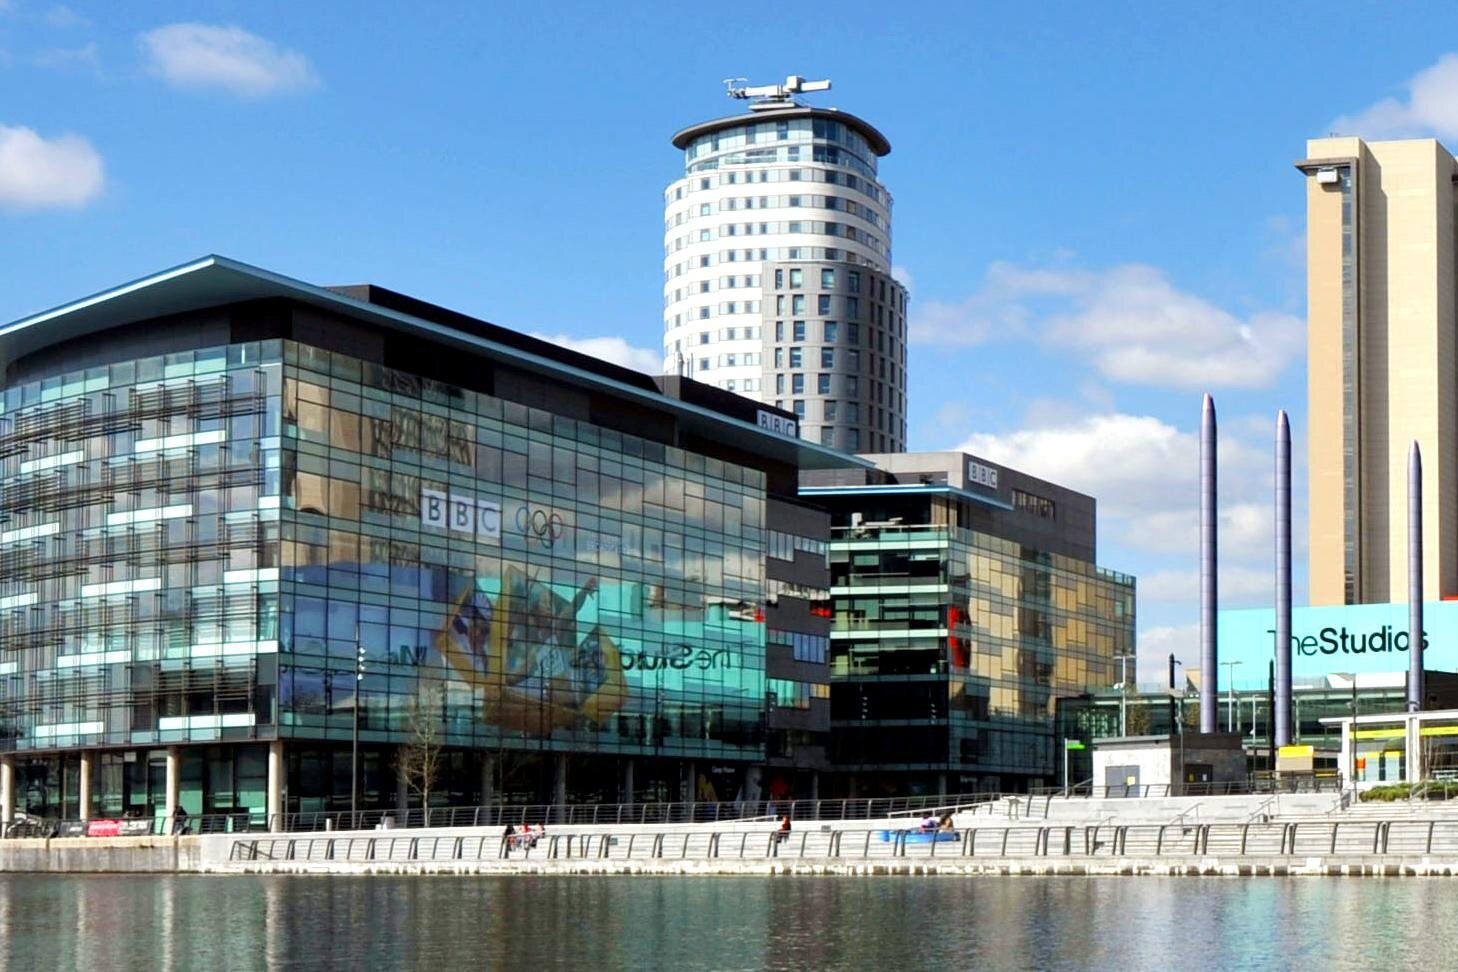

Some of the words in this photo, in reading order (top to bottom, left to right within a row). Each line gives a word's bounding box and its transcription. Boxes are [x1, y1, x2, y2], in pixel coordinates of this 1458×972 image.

[760, 413, 795, 438] BBC
[971, 464, 997, 486] BBC
[427, 495, 497, 532] BBC
